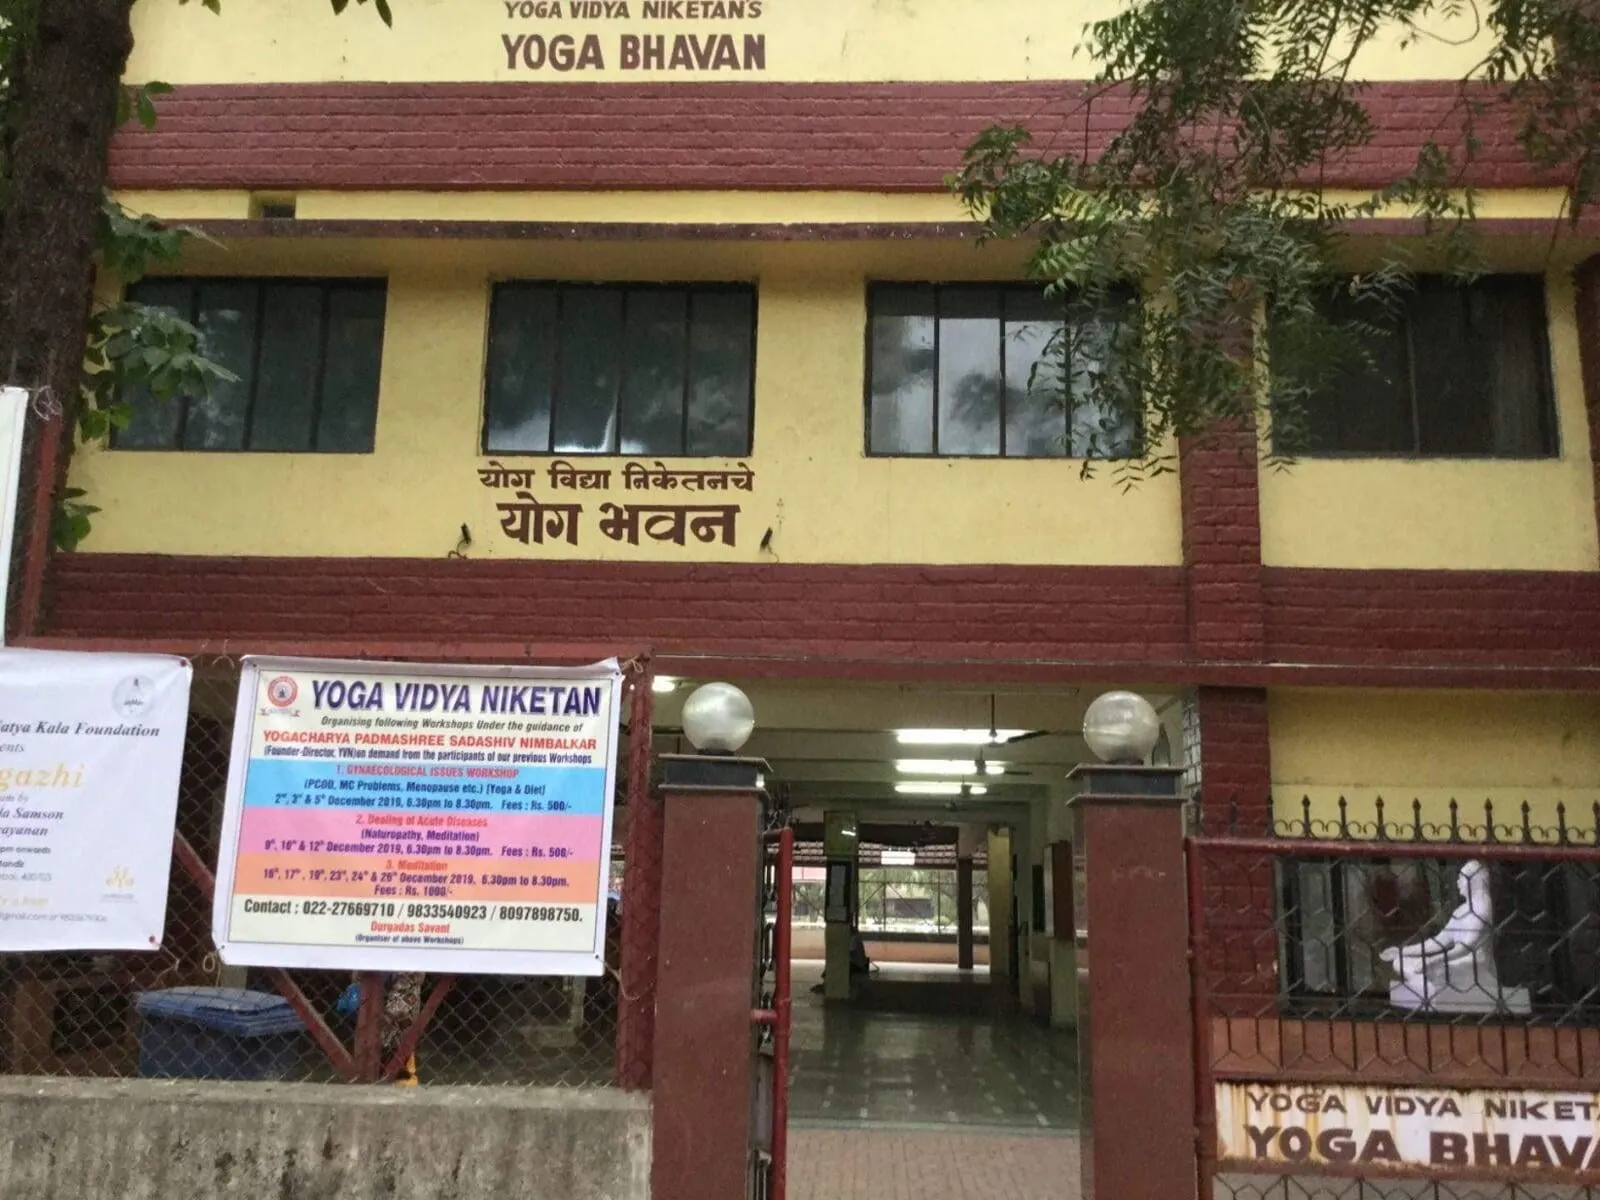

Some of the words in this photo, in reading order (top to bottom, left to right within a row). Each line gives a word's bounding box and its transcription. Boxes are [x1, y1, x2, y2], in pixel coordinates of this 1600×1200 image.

[506, 0, 563, 19] YOGA
[570, 0, 631, 19] VIDYA
[642, 0, 763, 19] NIKETAN'S
[501, 33, 605, 71] YOGA
[619, 33, 766, 70] BHAVAN
[477, 460, 535, 489] योग
[547, 460, 612, 490] विद्या
[496, 491, 584, 546] योग
[598, 502, 742, 547] भवन
[312, 680, 384, 710] YOGA
[395, 682, 471, 713] VIDYA
[480, 684, 602, 716] NIKETAN
[36, 721, 70, 735] Kala
[75, 722, 160, 737] Foundation
[321, 716, 373, 728] Organising
[375, 717, 418, 729] following
[421, 718, 474, 731] Workshops
[476, 720, 505, 731] Under
[507, 721, 524, 731] the
[526, 721, 570, 733] guidance
[573, 722, 584, 732] of
[263, 731, 351, 744] YOGACHARYA
[354, 733, 445, 747] PADMASHREE
[449, 736, 516, 749] SADASHIV
[520, 737, 598, 750] NIMBALKAR
[368, 747, 401, 759] demand
[402, 748, 421, 759] from
[422, 750, 436, 761] the
[437, 750, 485, 762] participants
[487, 751, 496, 761] of
[497, 752, 511, 762] our
[513, 752, 547, 763] previous
[549, 752, 593, 764] Workshops
[430, 766, 464, 778] ISSUES
[467, 767, 521, 779] WORKSHOP
[339, 779, 356, 790] MC
[406, 781, 460, 794] Menopause
[514, 784, 522, 795] &
[304, 793, 312, 804] &
[328, 794, 377, 806] December
[444, 798, 454, 808] to
[501, 799, 523, 810] Fees
[13, 807, 64, 820] Samson
[406, 816, 416, 826] of
[417, 816, 445, 826] Acute
[446, 816, 489, 827] Diseases
[299, 839, 306, 851] &
[326, 841, 376, 853] December
[444, 845, 454, 856] to
[501, 846, 523, 857] Fees
[370, 871, 378, 882] &
[399, 872, 448, 884] December
[519, 875, 530, 886] to
[374, 884, 397, 895] Fees
[244, 899, 292, 915] Contact
[302, 900, 395, 917] 022-27669710
[397, 904, 404, 919] /
[406, 903, 487, 919] 9833540923
[490, 905, 497, 921] /
[370, 921, 416, 932] Durgadas
[418, 922, 451, 933] Savant
[1246, 1091, 1348, 1114] YOGA
[1365, 1095, 1462, 1118] VIDYA
[1483, 1098, 1600, 1121] NIKET
[1243, 1125, 1403, 1164] YOGA
